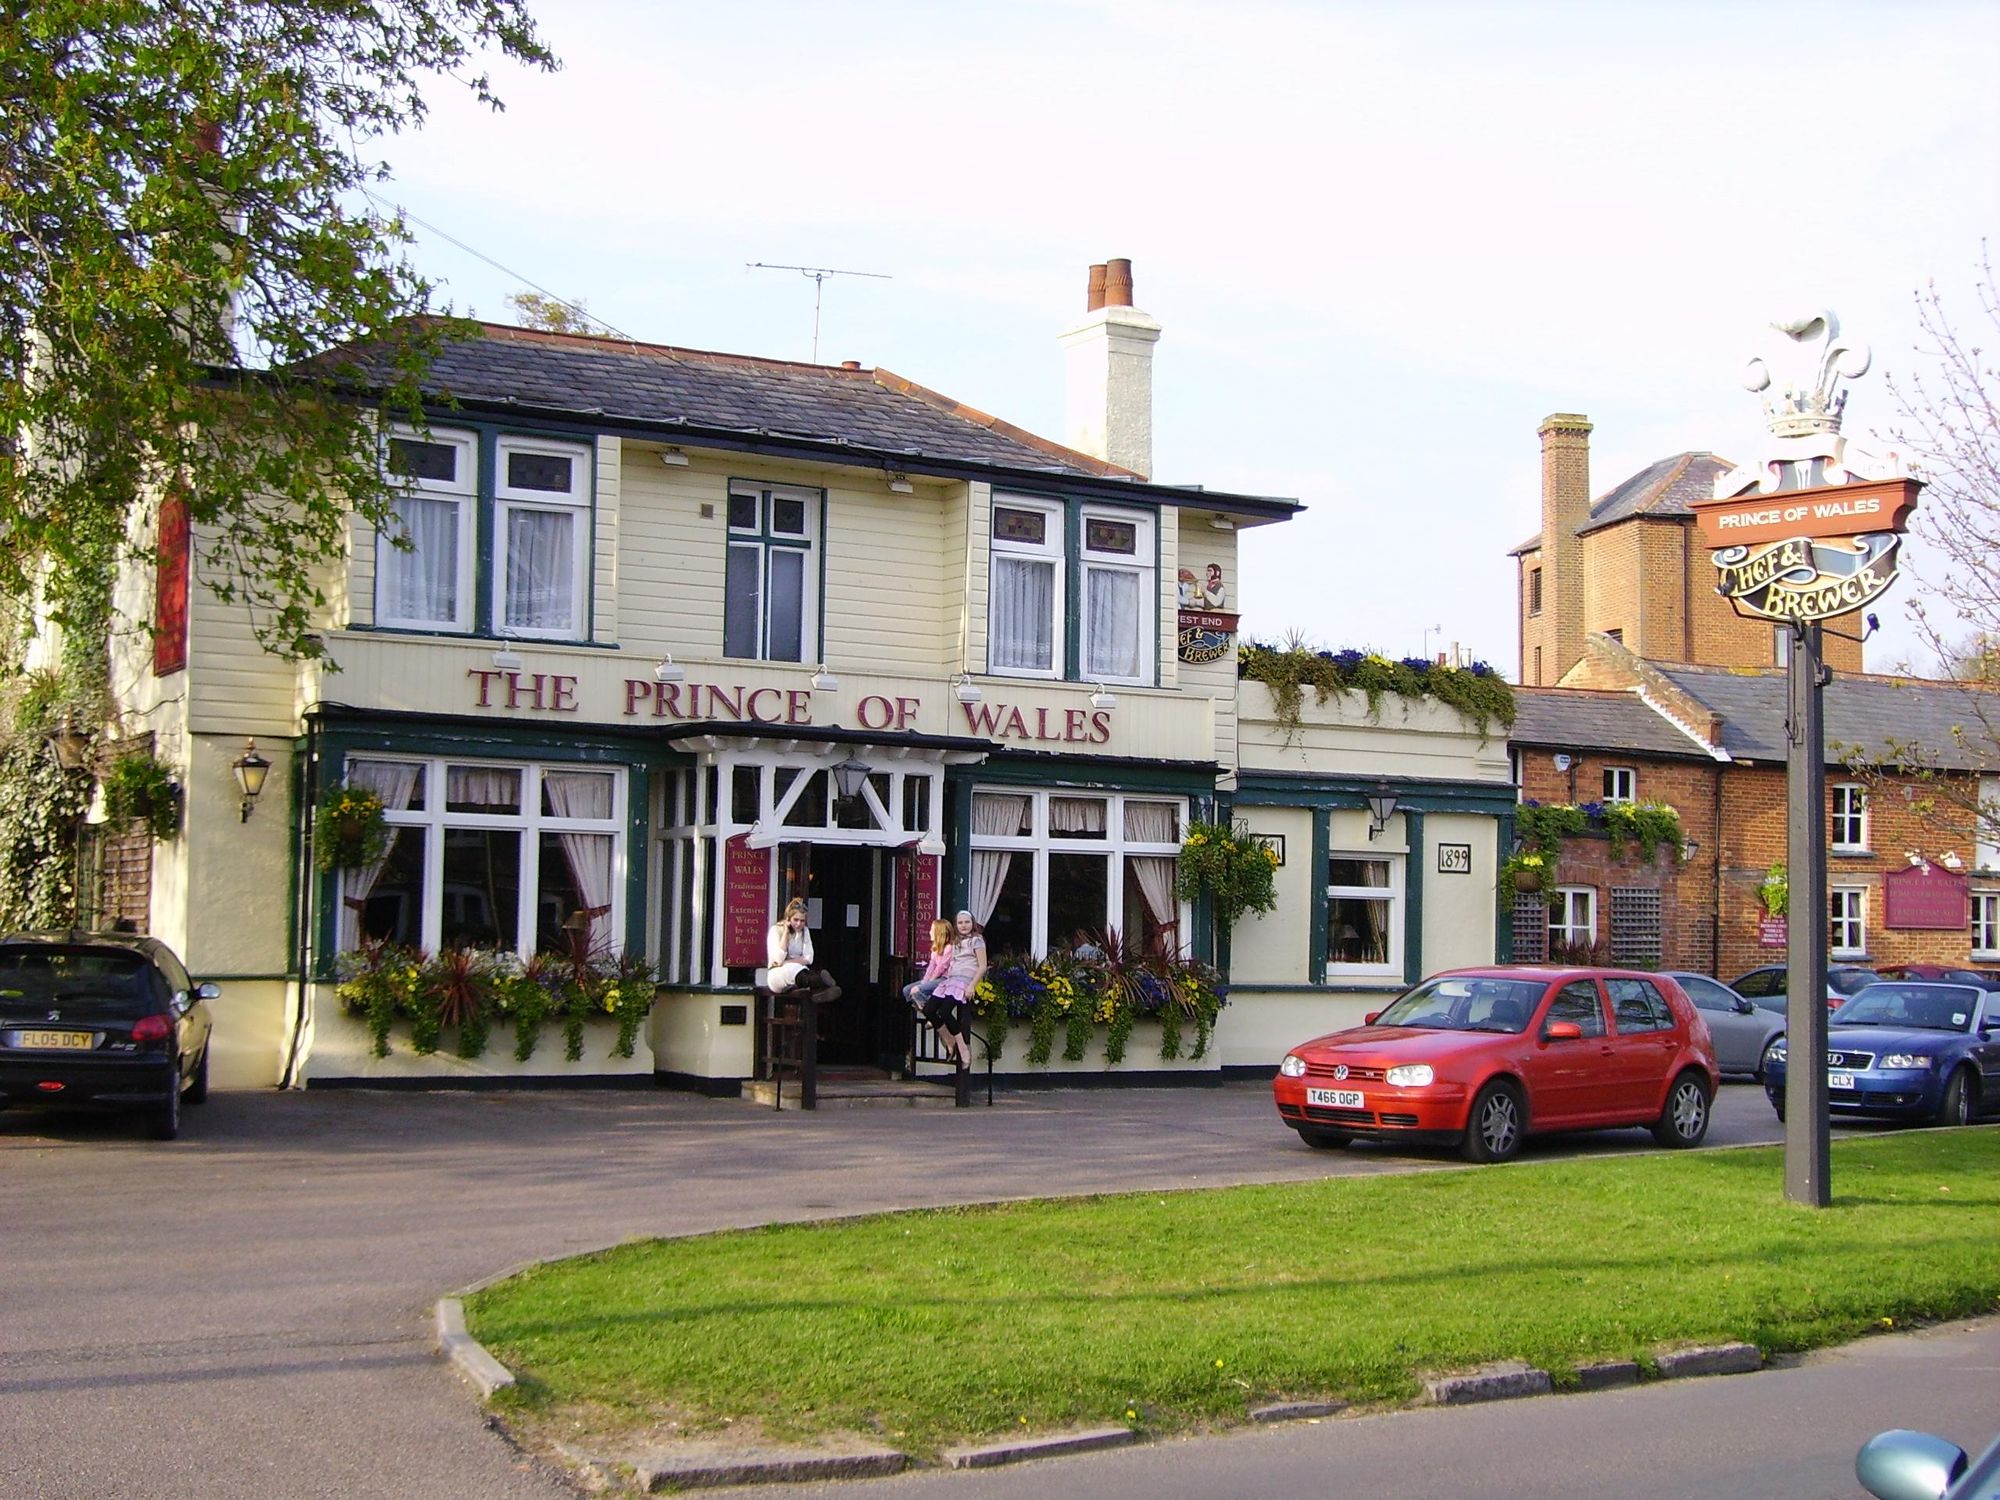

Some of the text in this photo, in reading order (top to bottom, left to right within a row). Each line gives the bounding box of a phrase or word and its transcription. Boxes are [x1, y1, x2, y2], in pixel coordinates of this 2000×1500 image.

[1719, 499, 1880, 530] PRINCE OF WALES
[1719, 543, 1804, 597] CHEF &
[1764, 568, 1886, 618] BREWER
[1178, 615, 1223, 626] EST END
[1184, 643, 1228, 661] BREWER
[468, 669, 1111, 744] THE PRINCE OF WALES
[732, 850, 765, 859] PRINCE
[1441, 849, 1468, 869] 1899
[735, 866, 763, 875] WALES
[730, 906, 766, 914] Extensive
[901, 901, 934, 909] Cked
[902, 911, 931, 920] FOD
[735, 926, 759, 935] by the
[735, 937, 757, 945] Bottle
[23, 1033, 89, 1048] FL05 DCY
[1833, 1075, 1852, 1086] CLX
[1311, 1090, 1360, 1105] T466 OGP
